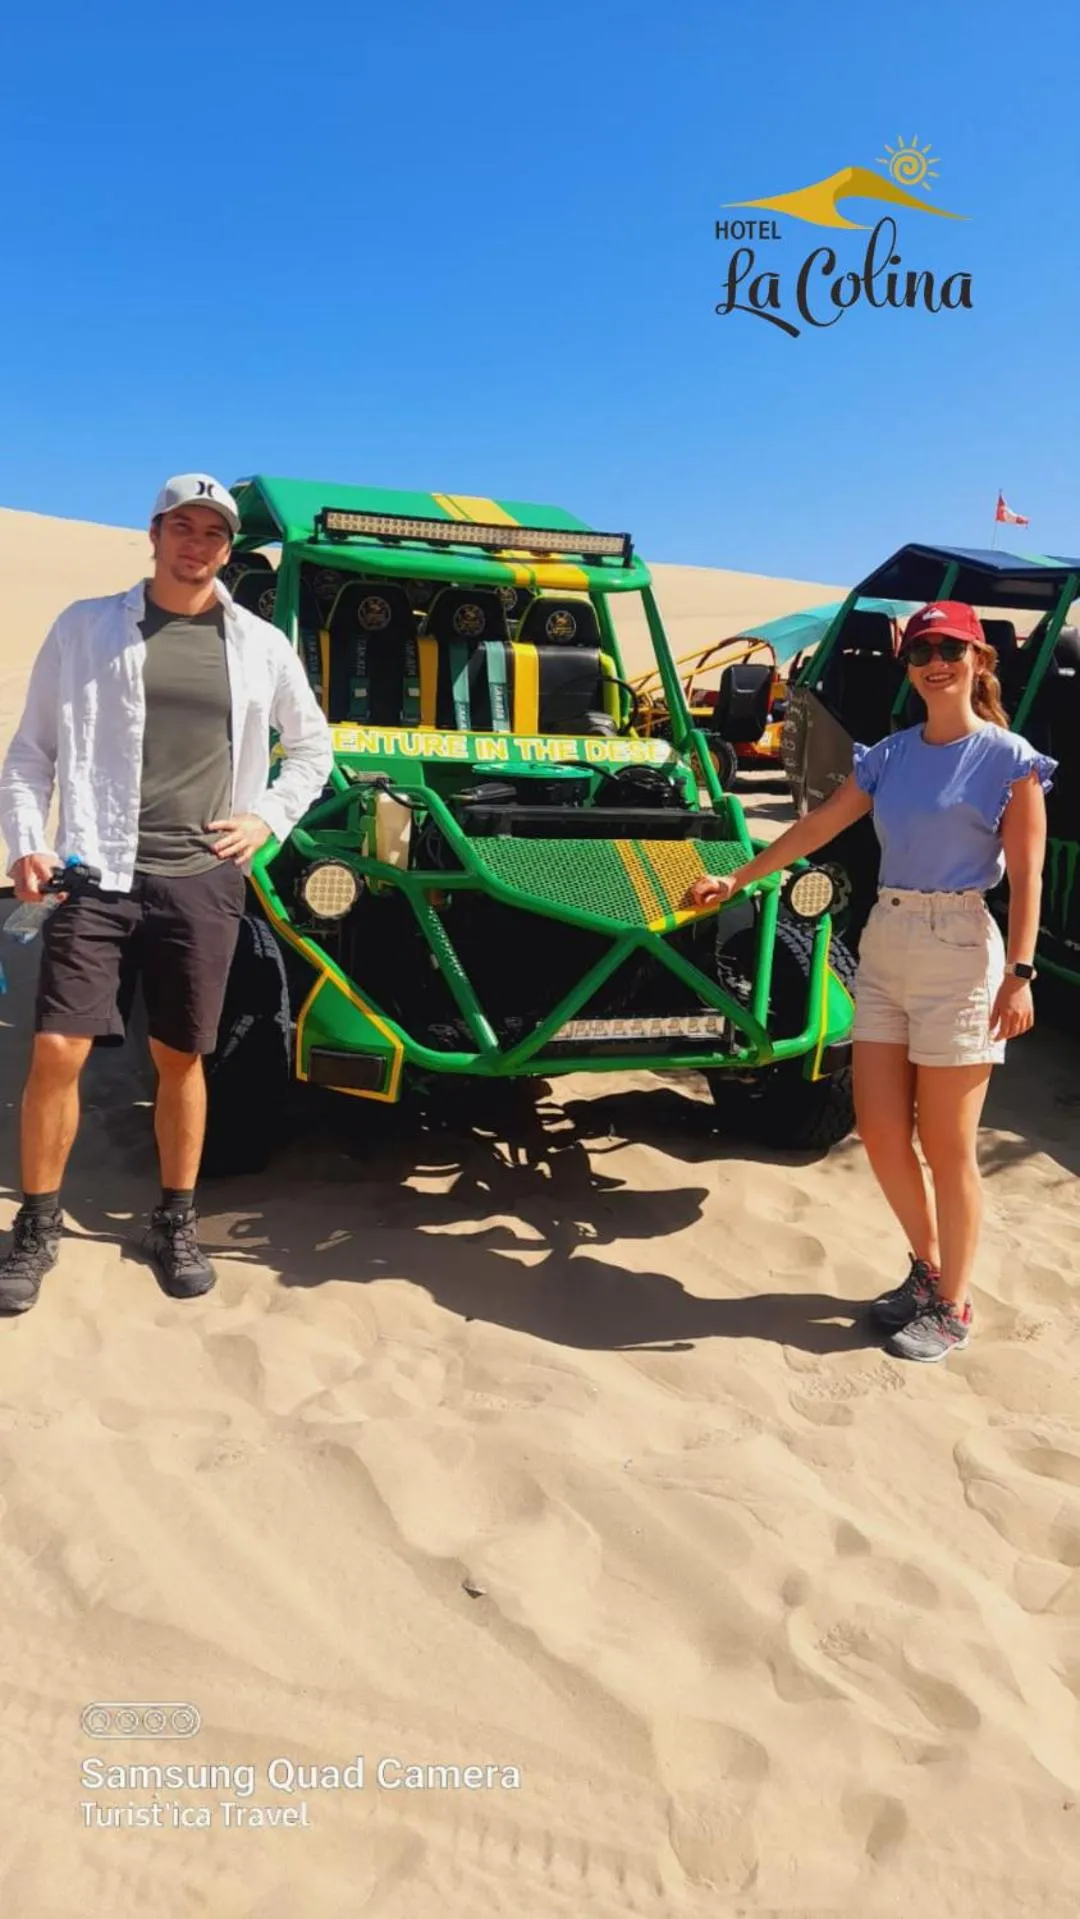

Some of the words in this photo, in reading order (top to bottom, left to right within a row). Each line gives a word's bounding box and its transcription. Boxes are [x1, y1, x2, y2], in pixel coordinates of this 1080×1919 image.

[333, 728, 469, 758] ENTURE
[475, 737, 509, 761] IN
[514, 738, 578, 763] THE
[584, 740, 669, 764] DESE
